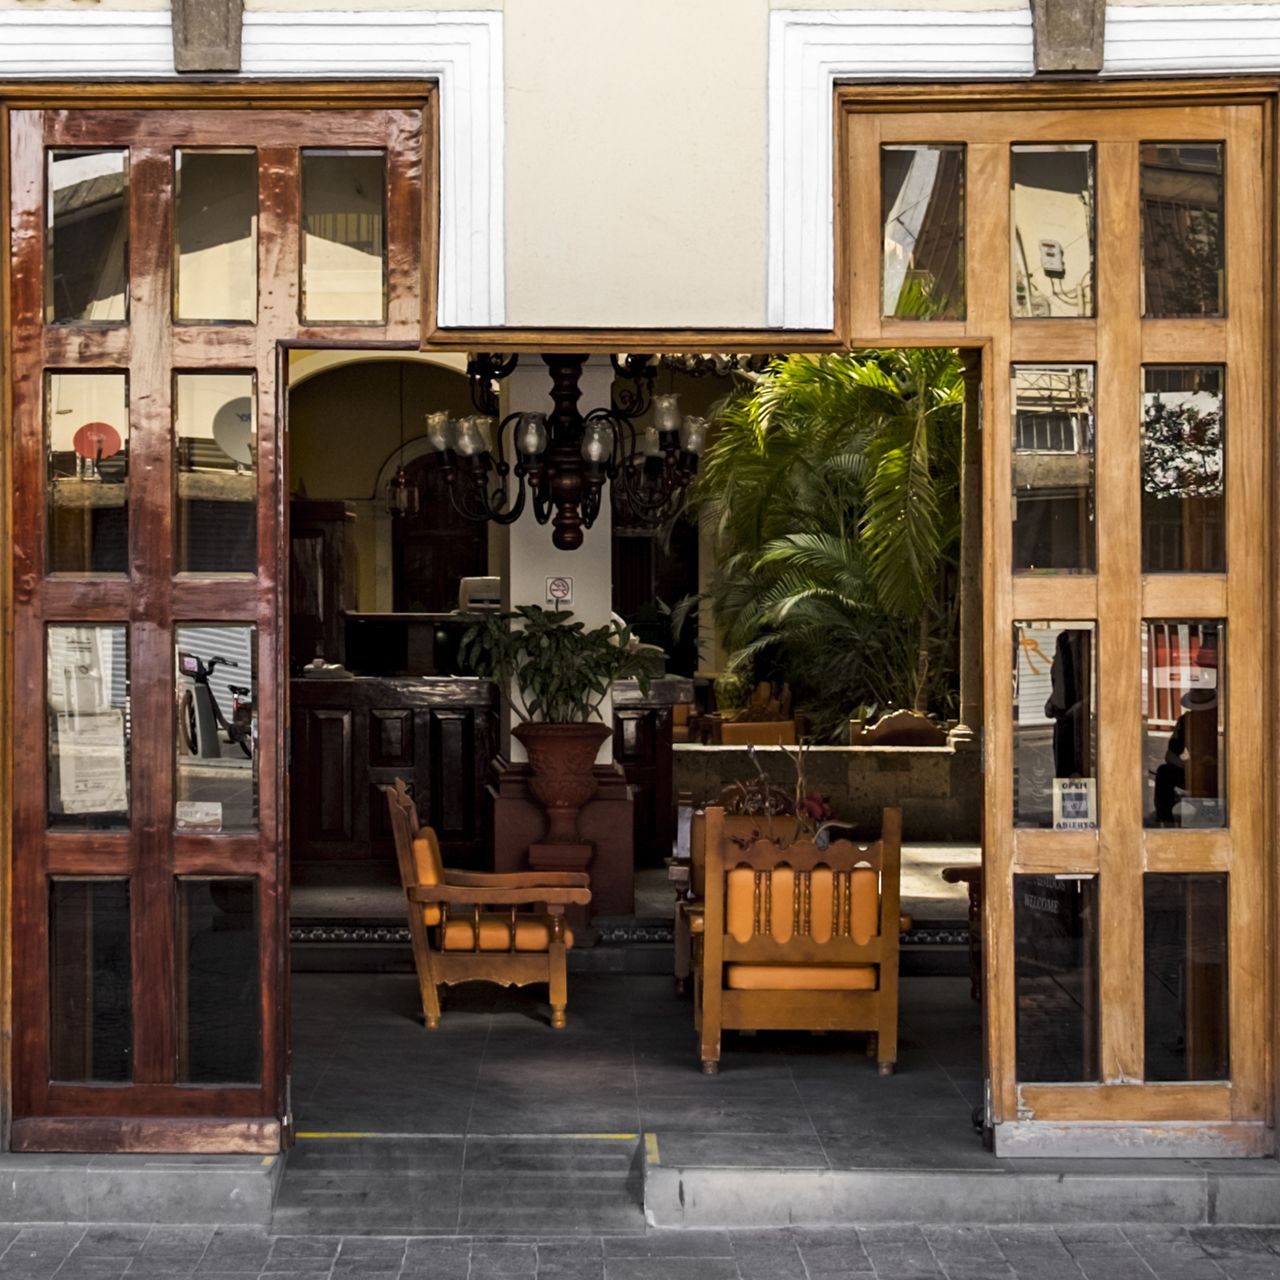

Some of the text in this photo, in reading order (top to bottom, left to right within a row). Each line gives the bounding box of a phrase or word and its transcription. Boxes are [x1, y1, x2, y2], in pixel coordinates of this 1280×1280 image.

[1061, 781, 1088, 790] OPEN
[1055, 821, 1096, 830] ABIERTO
[1023, 893, 1060, 914] WELCOME
